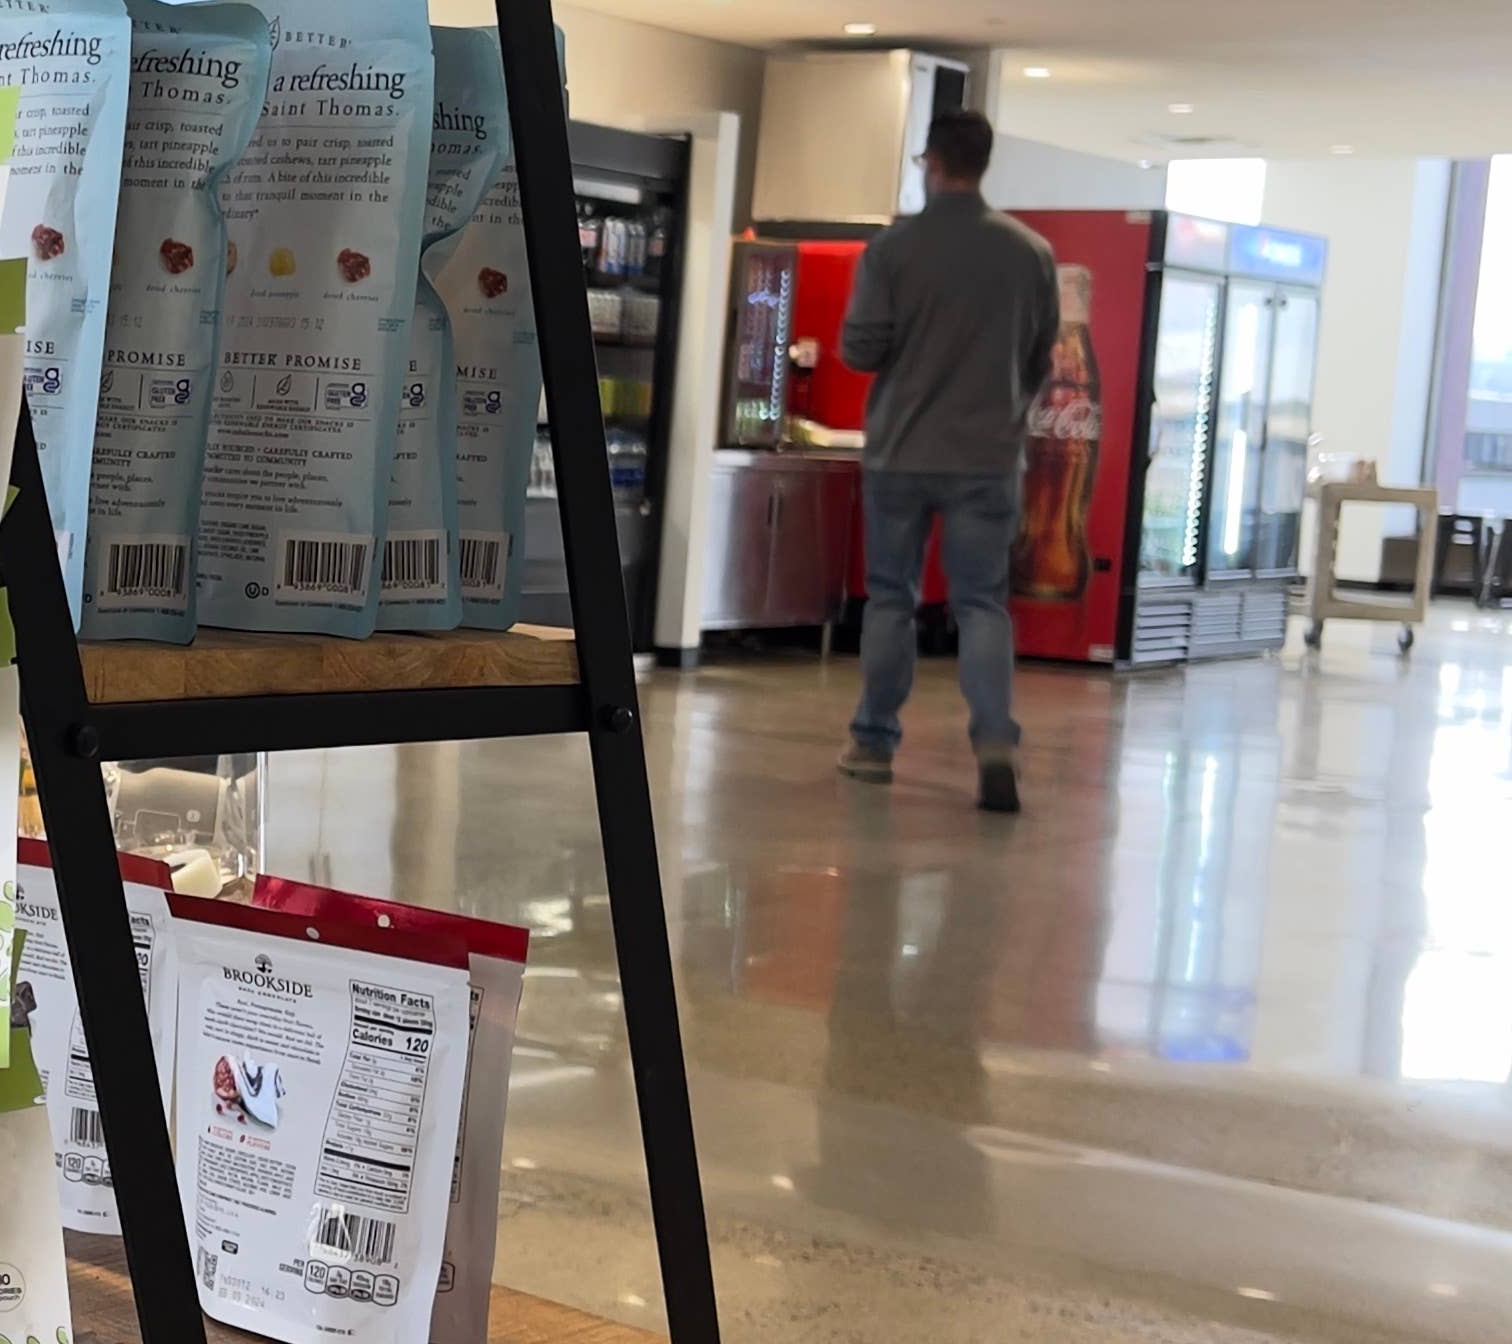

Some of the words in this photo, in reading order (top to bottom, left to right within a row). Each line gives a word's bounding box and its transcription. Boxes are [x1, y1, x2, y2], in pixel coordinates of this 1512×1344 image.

[20, 66, 95, 86] Thomas.
[273, 75, 286, 92] a
[290, 62, 406, 98] refreshing
[141, 81, 232, 106] Thomas.
[261, 102, 306, 117] Saint
[317, 98, 400, 117] Thomas.
[180, 122, 223, 137] toasted
[161, 139, 220, 156] pineapple
[296, 137, 318, 151] pair
[152, 159, 217, 175] incredible
[334, 173, 390, 186] incredible
[300, 190, 344, 202] moment
[350, 189, 361, 202] in
[369, 189, 388, 203] the
[222, 966, 315, 999] BROOKSIDE
[352, 984, 397, 1002] Nutrition
[400, 994, 431, 1010] Facts
[352, 1028, 394, 1047] Calories
[405, 1036, 430, 1054] 120
